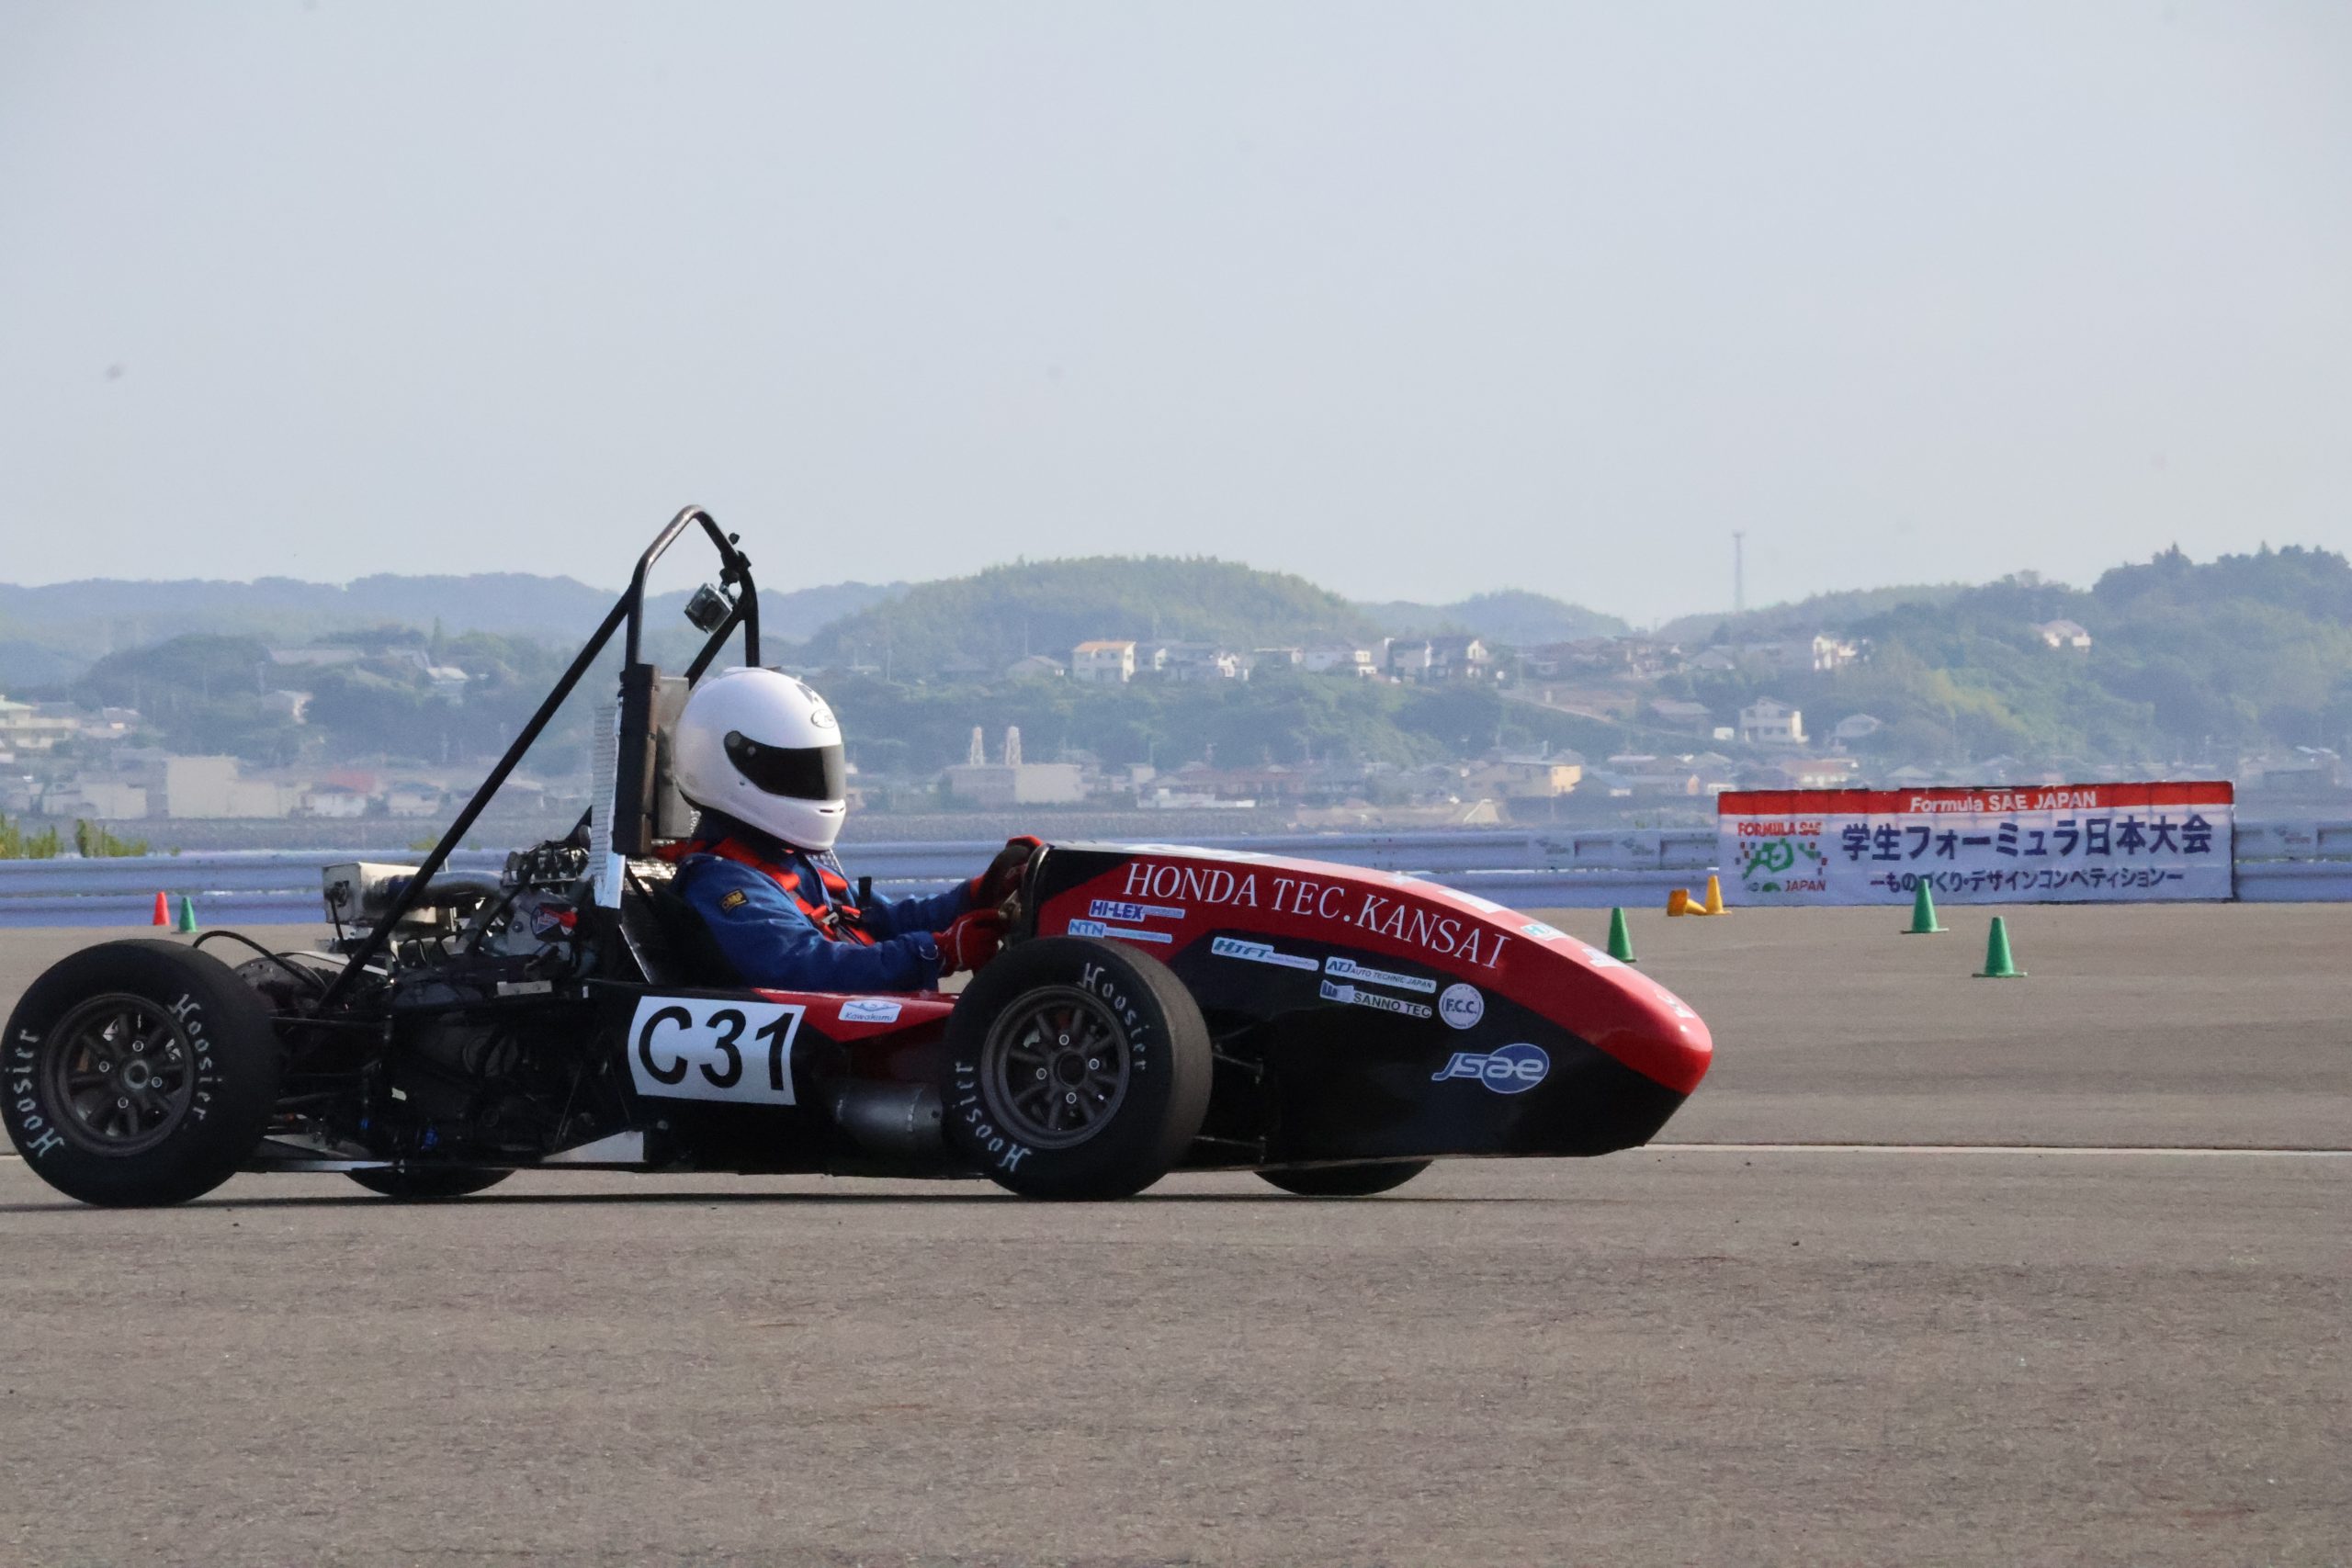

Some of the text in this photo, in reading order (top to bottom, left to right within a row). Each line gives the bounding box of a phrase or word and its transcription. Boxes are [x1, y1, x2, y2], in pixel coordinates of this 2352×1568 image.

[1910, 791, 2097, 812] Formula SAE JAPAN
[1738, 822, 1822, 836] FORMULA SAE
[1842, 814, 2212, 861] 学生フォーミュラ日本大会
[1122, 863, 1258, 907] HONDA
[1785, 880, 1826, 891] JAPAN
[1091, 900, 1144, 919] HI-LEX
[1069, 920, 1104, 935] NTN
[1351, 969, 1372, 977] AUTO
[1407, 978, 1432, 987] JAPAN
[1353, 993, 1430, 1017] SANNO TEC
[1445, 998, 1477, 1014] F.C.C.
[639, 1006, 795, 1090] C31
